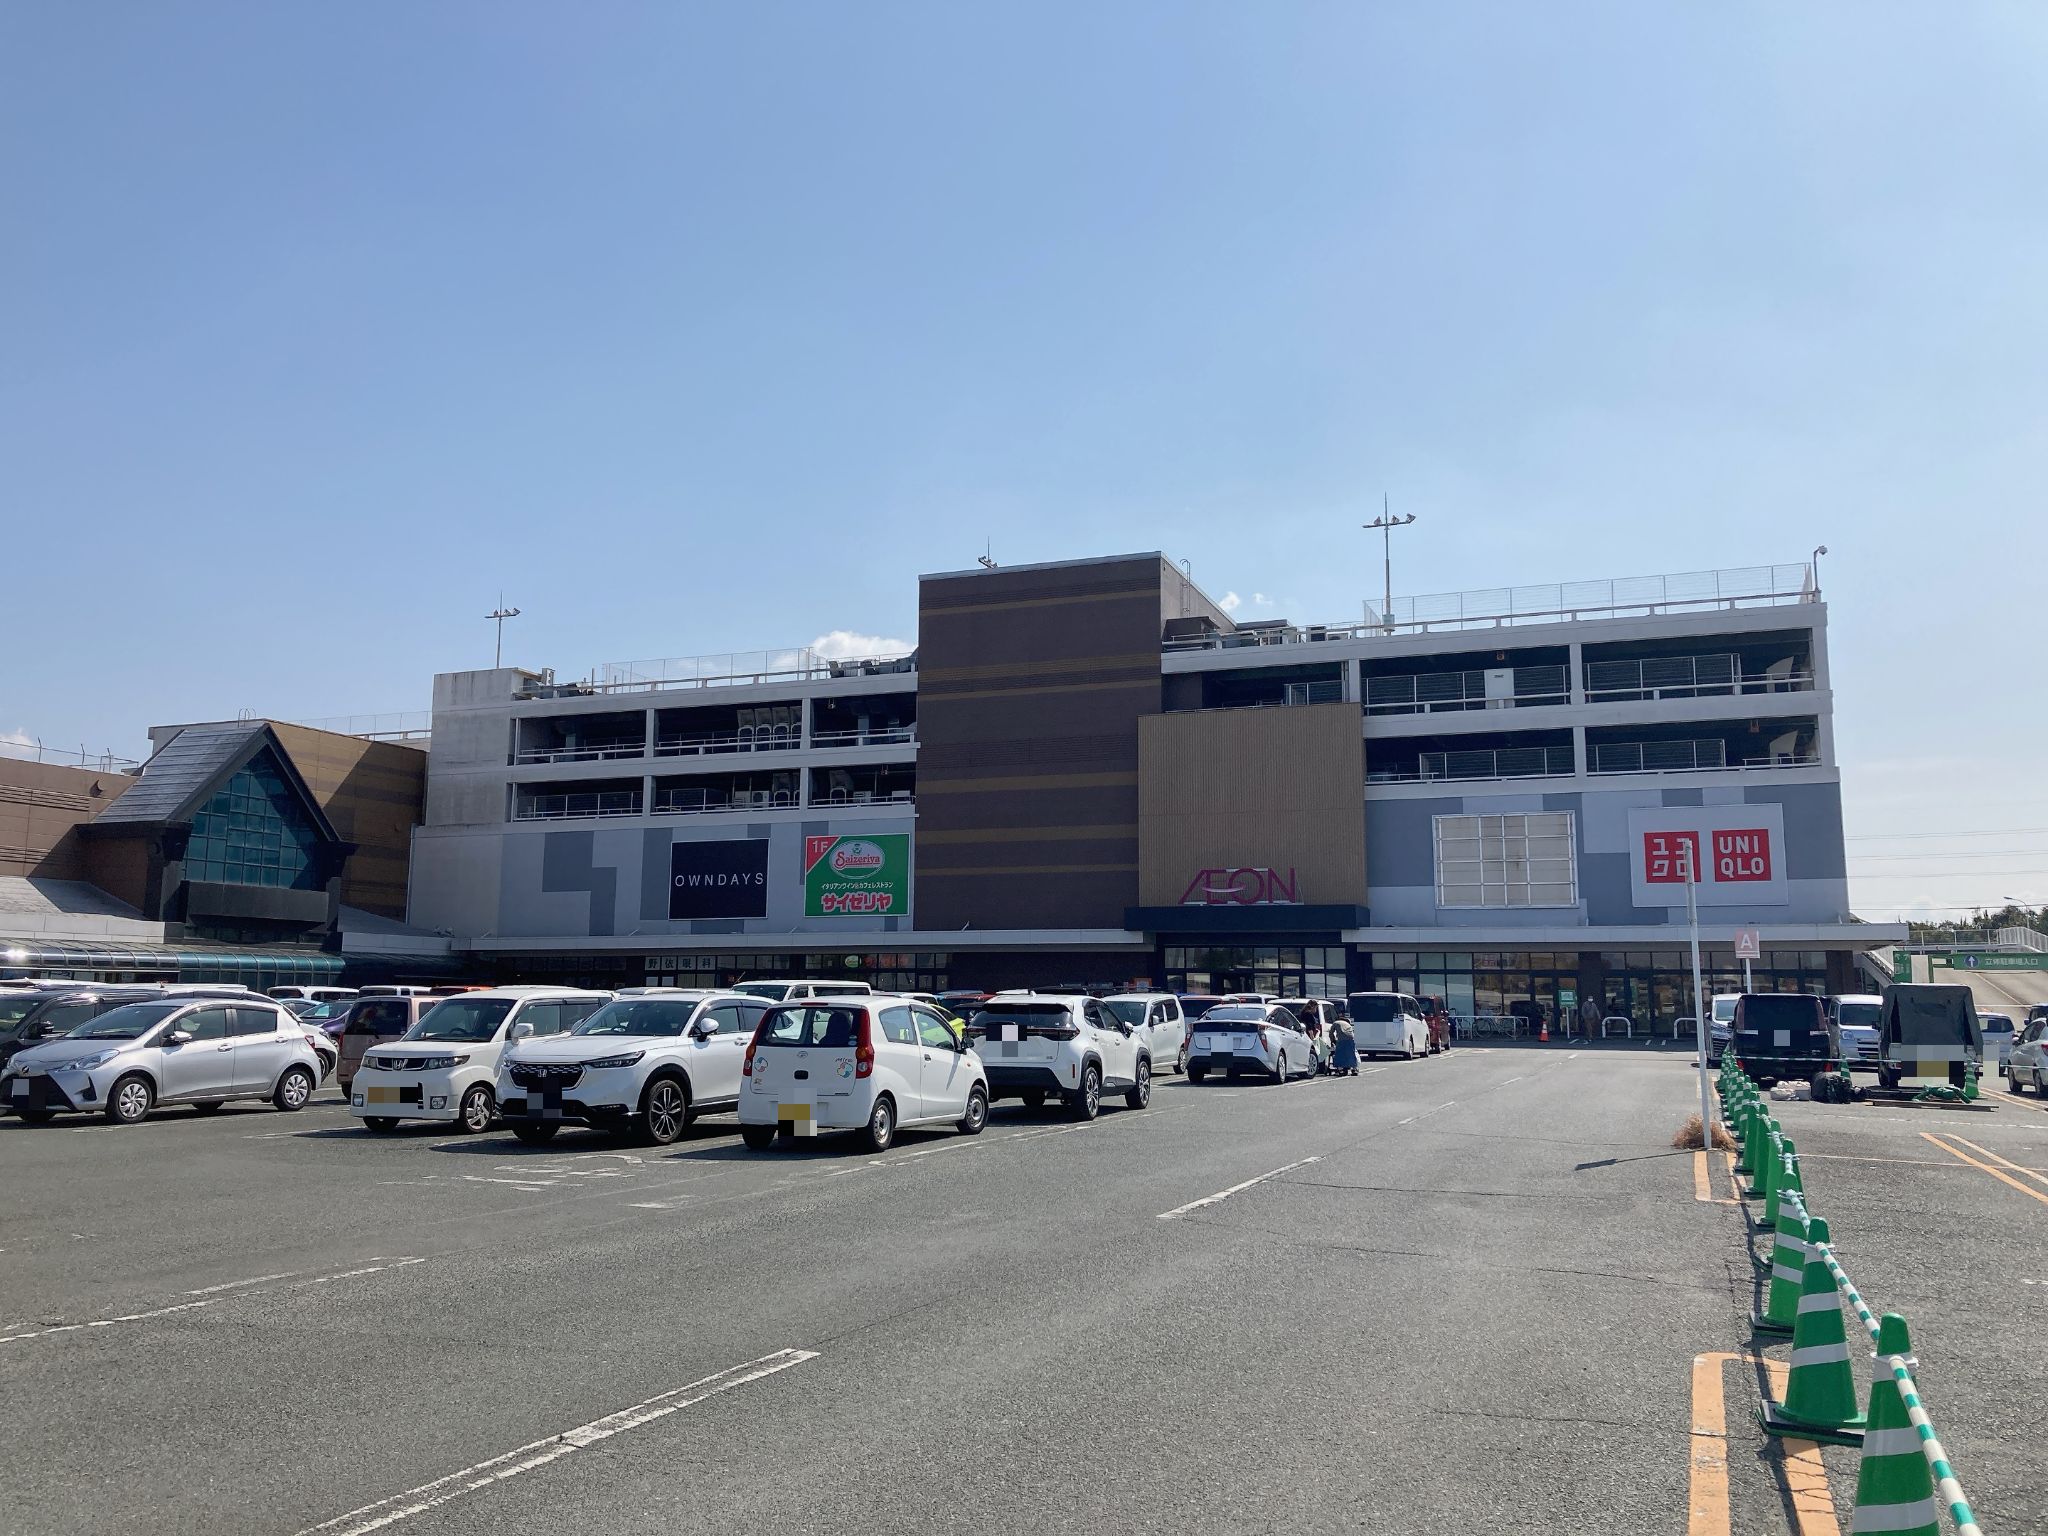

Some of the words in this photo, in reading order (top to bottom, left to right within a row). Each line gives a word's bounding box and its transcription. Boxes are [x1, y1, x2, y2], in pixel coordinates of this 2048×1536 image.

[813, 840, 828, 853] 1F
[1719, 836, 1758, 854] UNI
[833, 849, 881, 869] Saizeriya
[1720, 857, 1764, 878] QLO
[675, 872, 763, 887] OWNDAYS
[821, 891, 893, 912] サイゼリヤ
[1740, 934, 1753, 949] A
